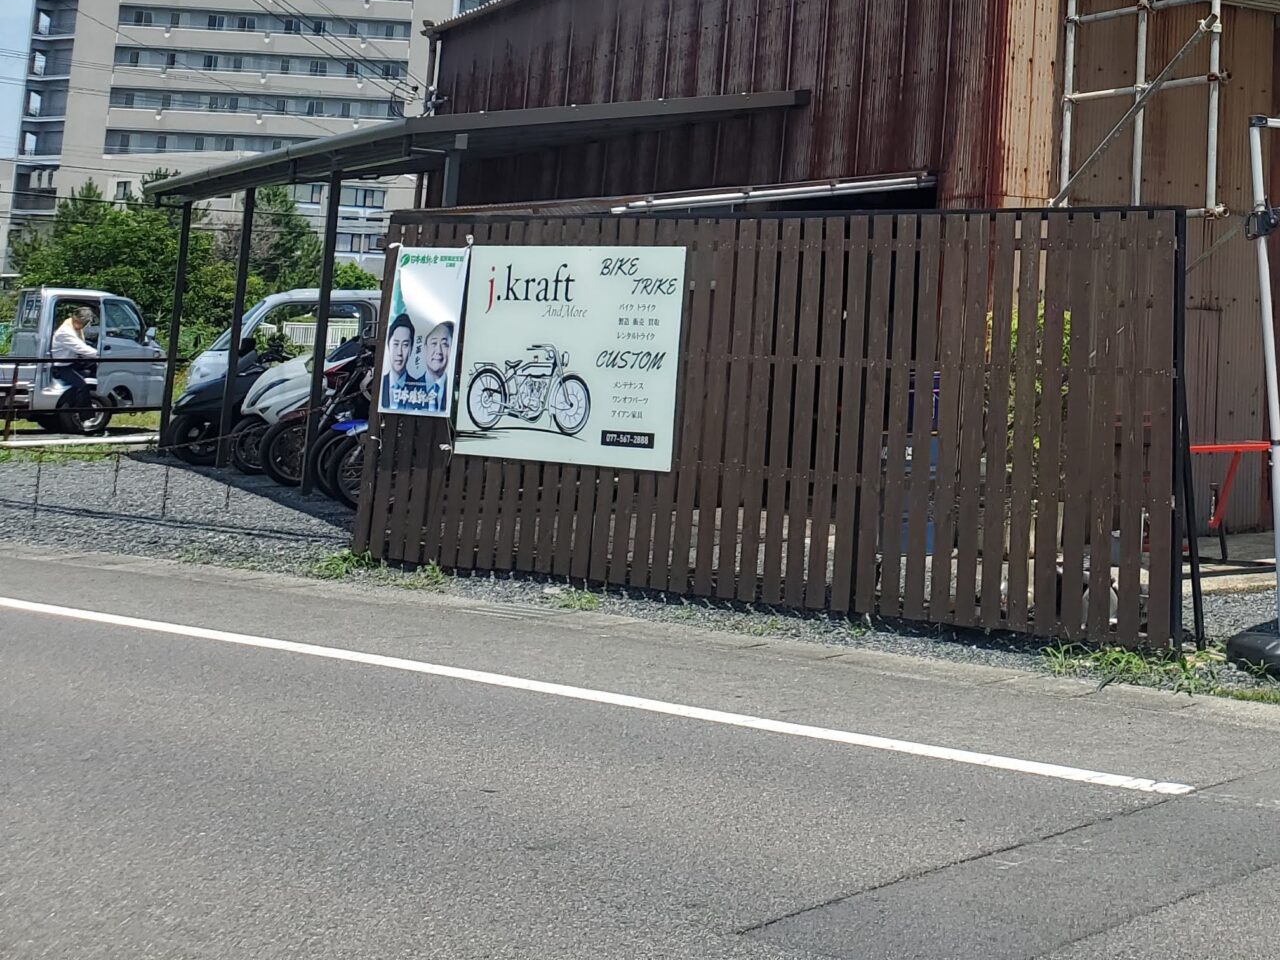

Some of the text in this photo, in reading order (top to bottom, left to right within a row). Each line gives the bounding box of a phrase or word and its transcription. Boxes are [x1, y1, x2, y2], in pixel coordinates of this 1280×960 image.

[600, 257, 640, 276] BIKE
[485, 263, 575, 314] j.kraft
[631, 278, 678, 295] TRIKE
[595, 350, 667, 372] CUSTOM
